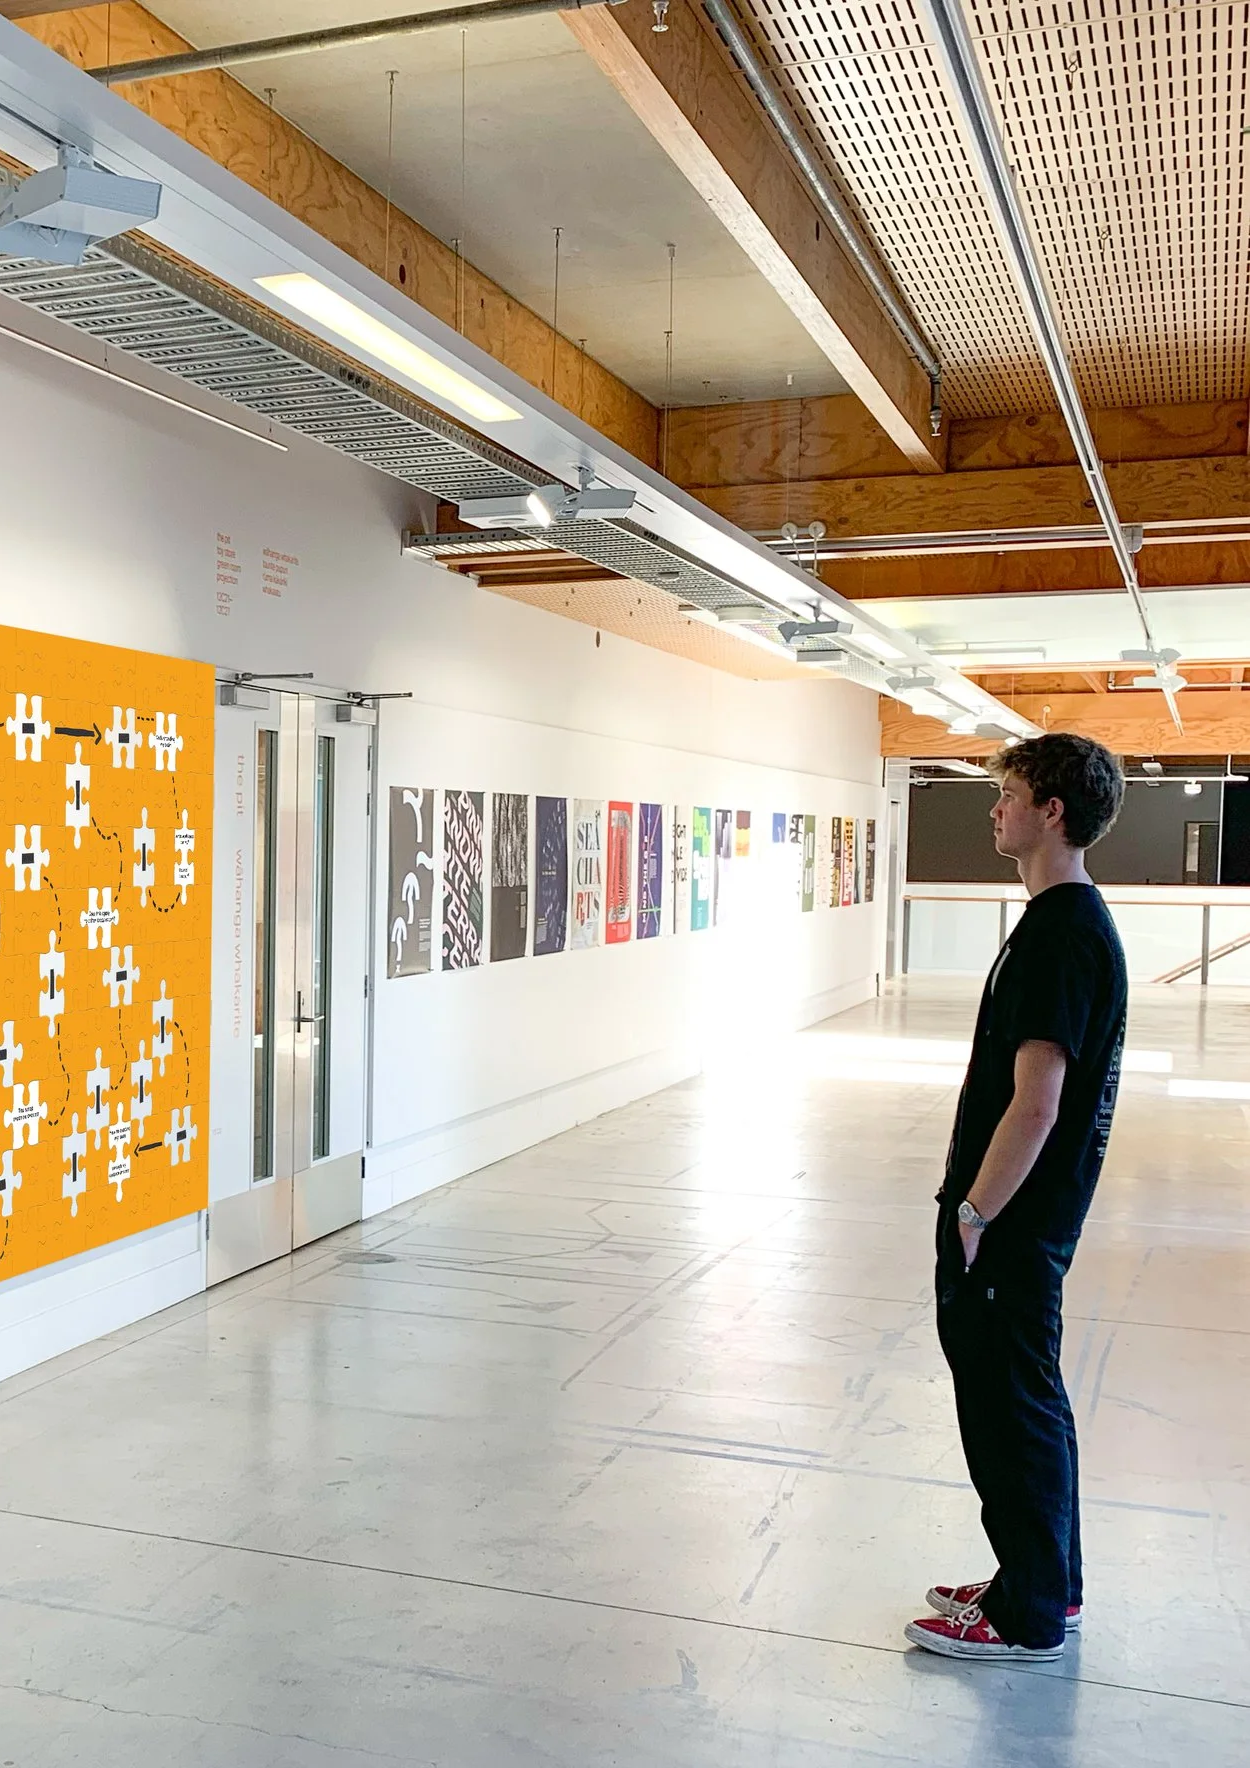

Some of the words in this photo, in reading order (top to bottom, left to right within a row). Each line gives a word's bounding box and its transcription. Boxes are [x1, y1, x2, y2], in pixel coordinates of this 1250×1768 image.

[236, 753, 245, 787] the
[235, 791, 246, 818] pit
[576, 817, 602, 851] SEA
